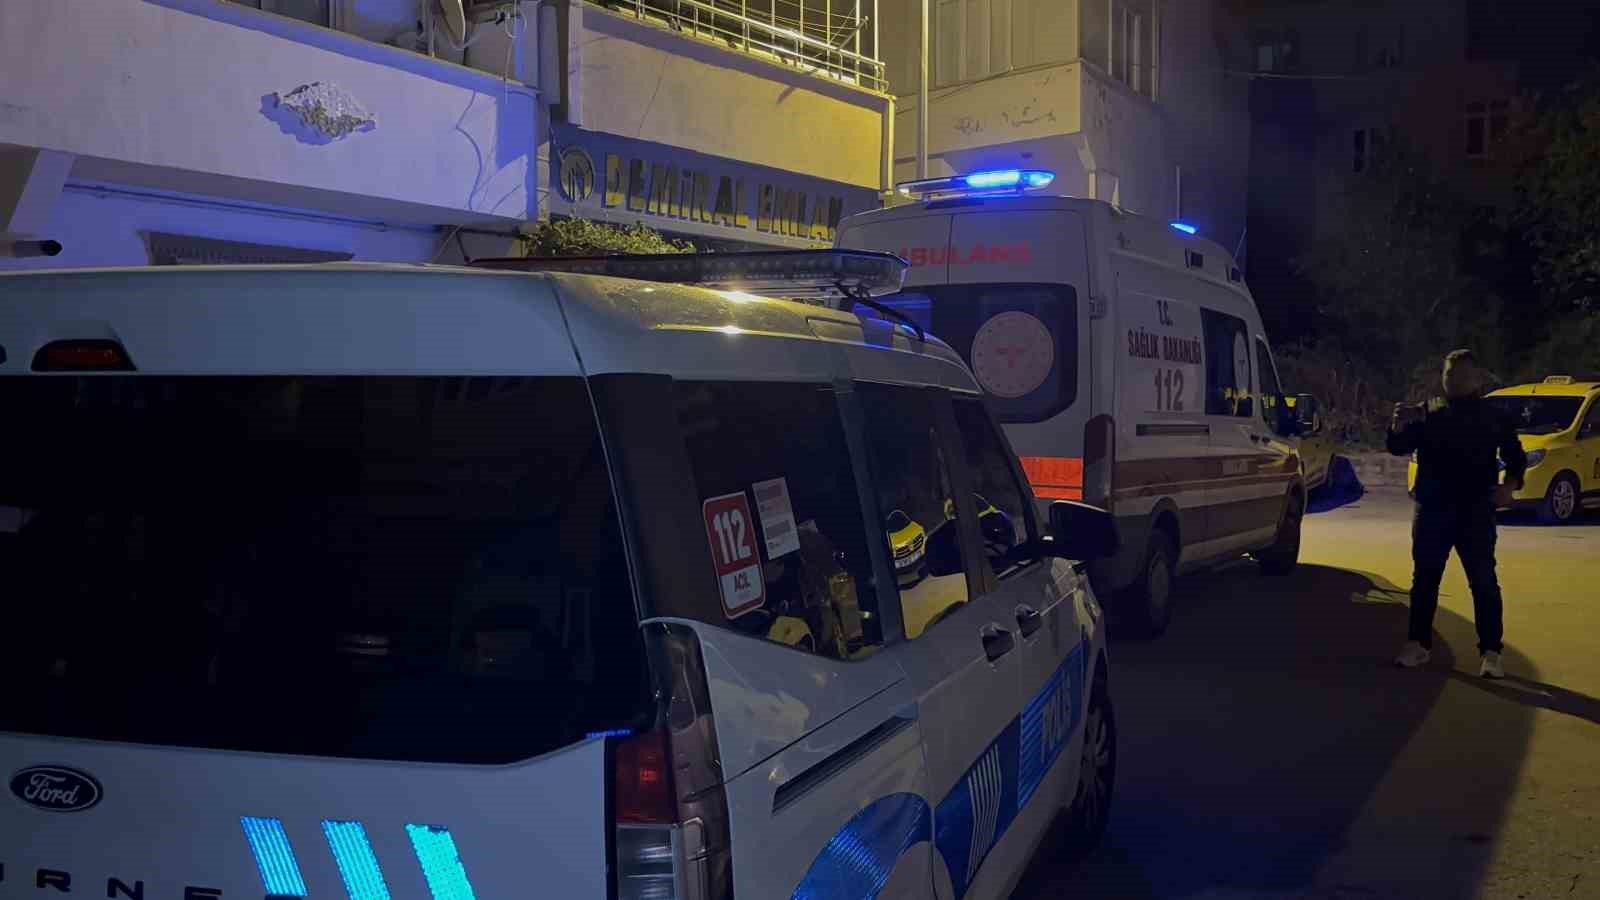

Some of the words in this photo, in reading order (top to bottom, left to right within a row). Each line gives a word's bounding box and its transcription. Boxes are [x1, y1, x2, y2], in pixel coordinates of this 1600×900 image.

[1127, 326, 1161, 361] SAĞLIK
[1154, 367, 1184, 411] 112
[712, 508, 752, 565] 112
[24, 772, 80, 805] Ford
